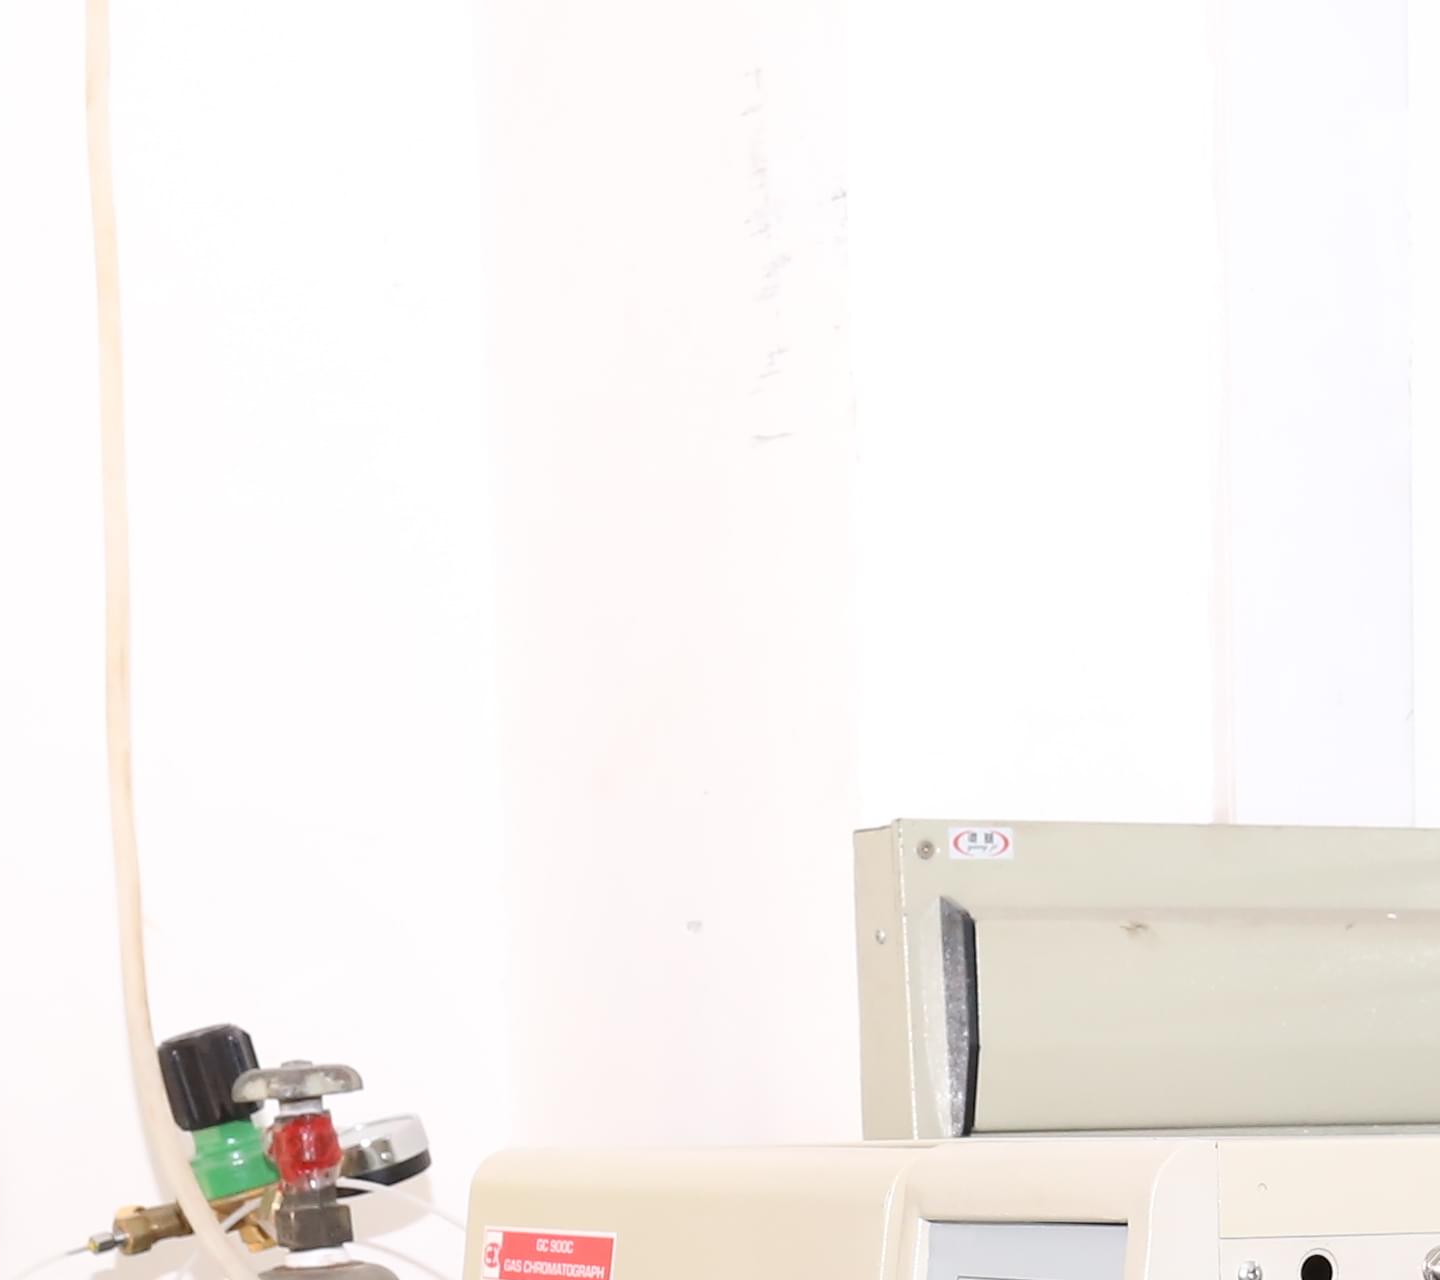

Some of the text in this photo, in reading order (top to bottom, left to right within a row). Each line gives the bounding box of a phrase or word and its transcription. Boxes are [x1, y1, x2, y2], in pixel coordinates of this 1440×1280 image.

[536, 1238, 549, 1253] GC
[503, 1258, 605, 1279] GAS CHROMATOGRAPH
